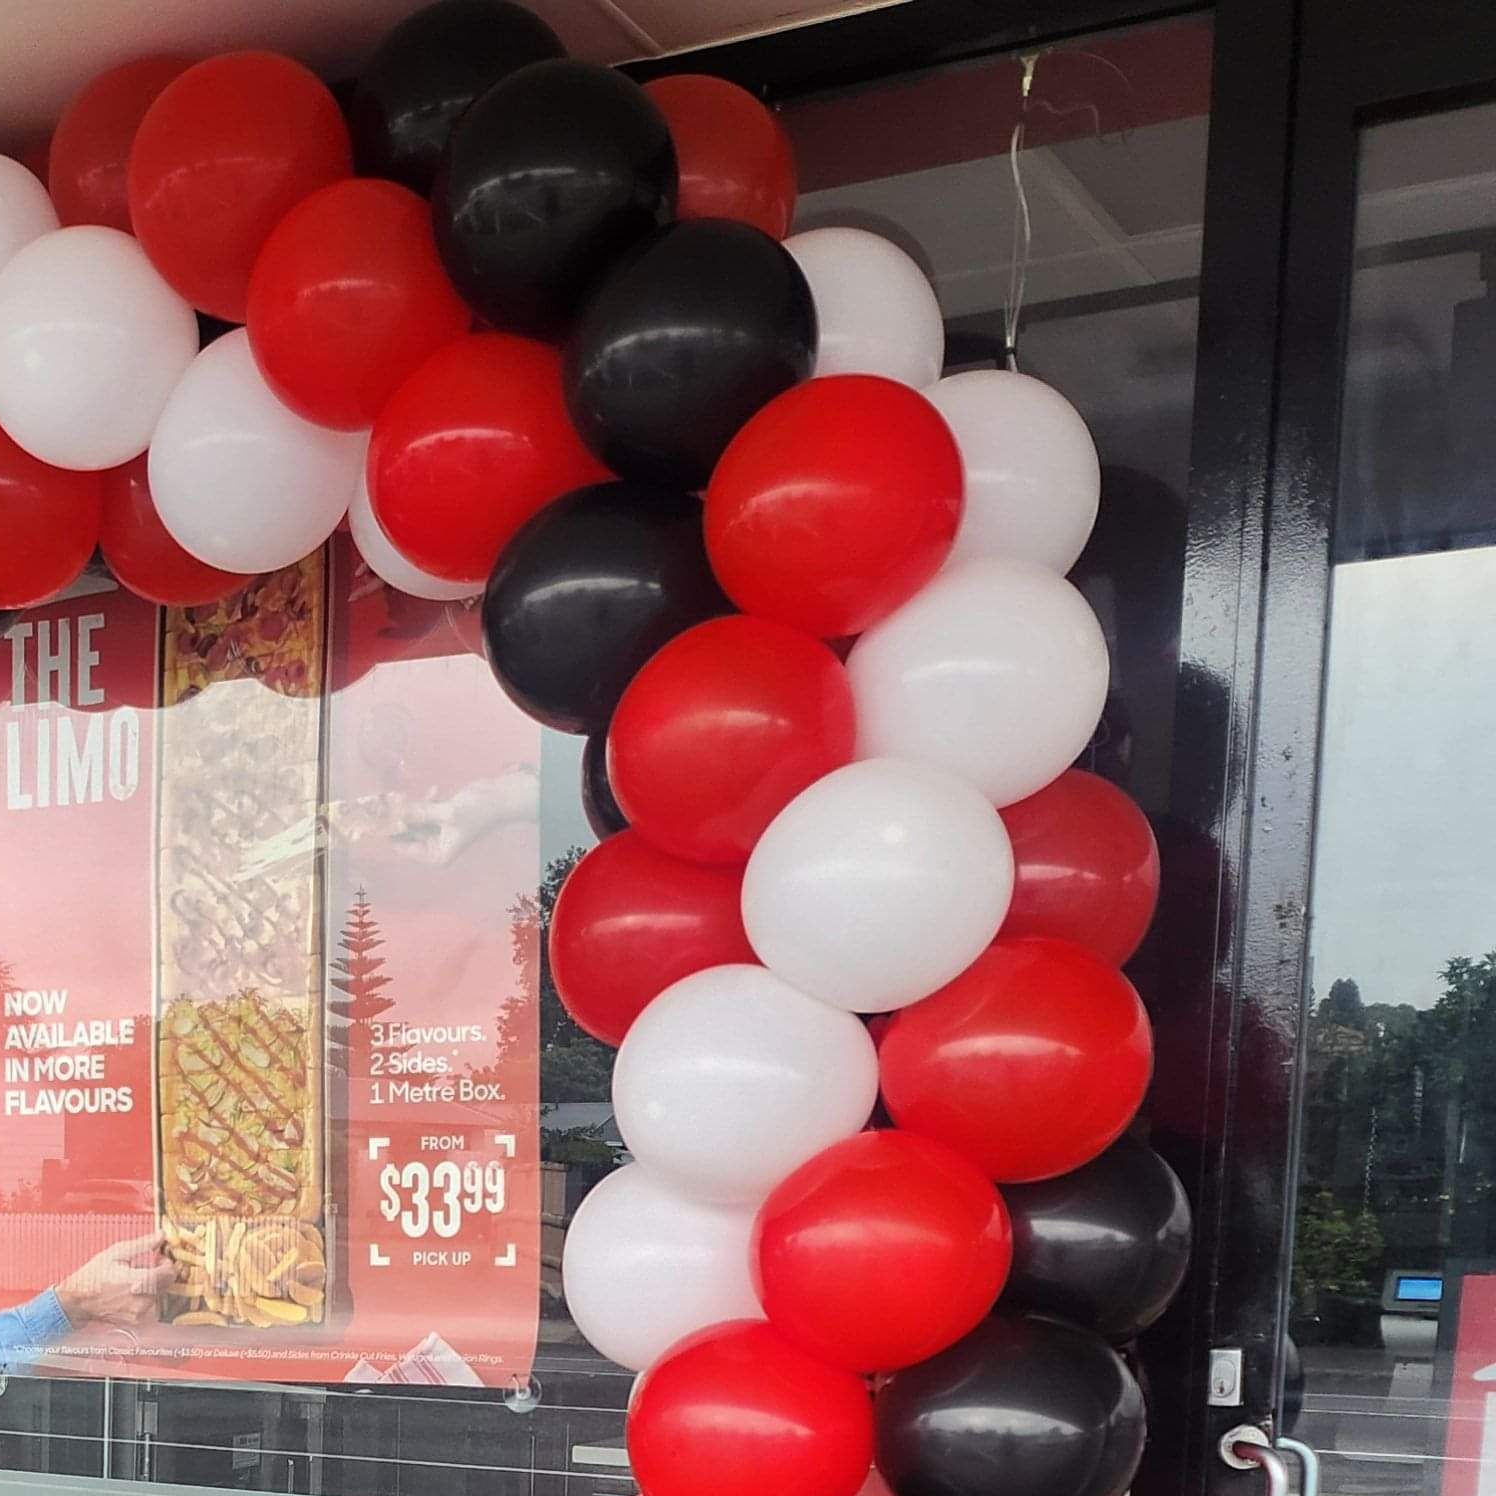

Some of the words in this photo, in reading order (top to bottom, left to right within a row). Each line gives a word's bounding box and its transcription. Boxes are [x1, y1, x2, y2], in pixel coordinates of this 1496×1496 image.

[4, 613, 104, 712] THE
[7, 706, 140, 810] LIMO
[5, 989, 67, 1017] NOW
[5, 1018, 135, 1050] AVAILABLE
[370, 1024, 384, 1047] 3
[389, 1023, 487, 1046] Flavours.
[6, 1057, 29, 1082] IN
[34, 1054, 105, 1081] MORE
[370, 1053, 384, 1075] 2
[5, 1086, 133, 1116] FLAVOURS
[370, 1081, 384, 1104] 1
[389, 1080, 455, 1104] Metre
[460, 1079, 505, 1101] Box.
[421, 1135, 464, 1150] FROM
[413, 1251, 448, 1266] PICK
[452, 1251, 471, 1265] UP
